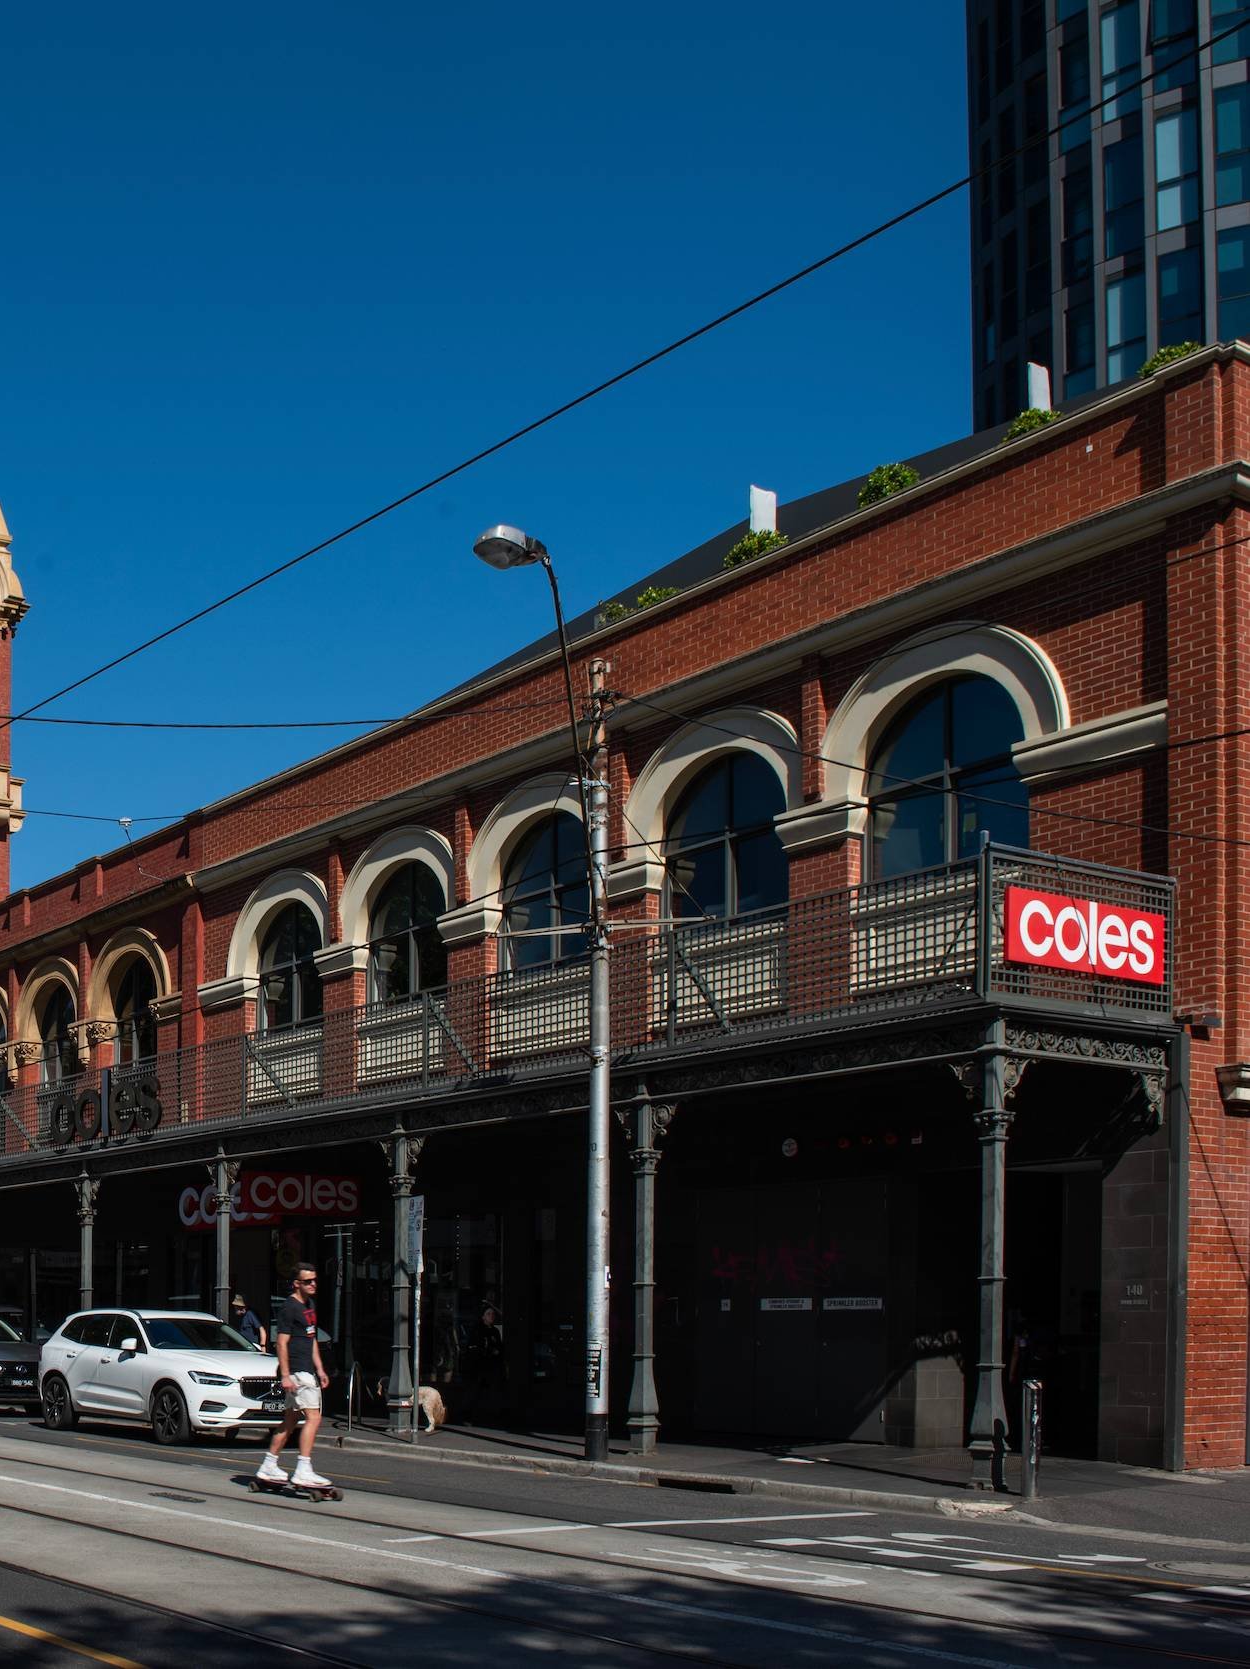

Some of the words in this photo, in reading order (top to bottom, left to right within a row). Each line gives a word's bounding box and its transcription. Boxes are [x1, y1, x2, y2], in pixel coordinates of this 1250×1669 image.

[1019, 899, 1155, 975] coles
[51, 1068, 162, 1144] coles
[250, 1175, 359, 1213] coles
[1126, 1284, 1143, 1296] 140
